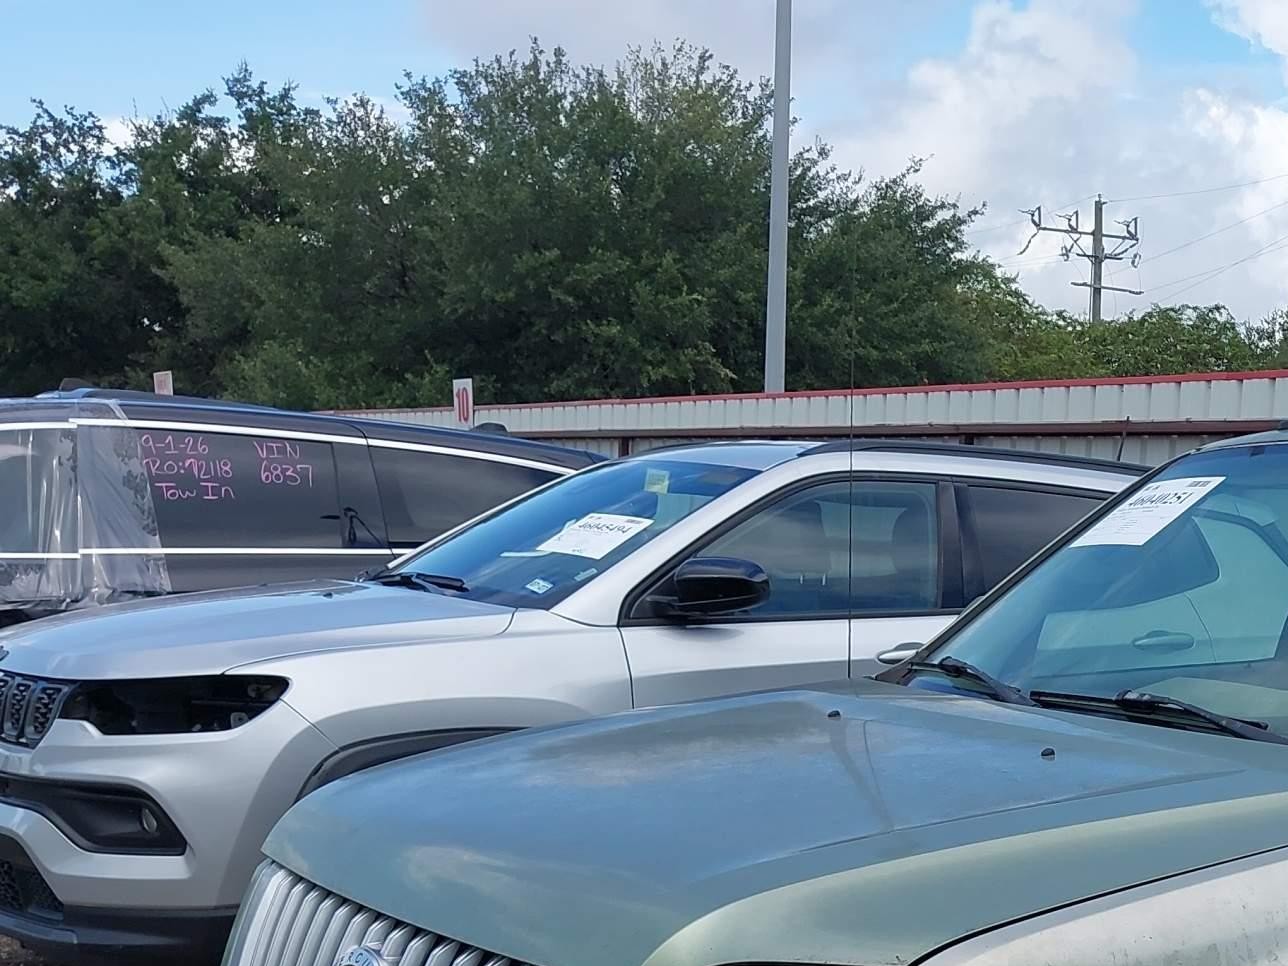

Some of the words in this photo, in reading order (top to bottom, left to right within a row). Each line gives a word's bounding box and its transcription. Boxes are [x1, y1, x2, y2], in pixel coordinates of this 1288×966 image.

[455, 386, 470, 424] 10
[141, 434, 209, 454] 9-1-26
[253, 440, 300, 459] VIN
[260, 460, 313, 488] 6837
[154, 483, 197, 500] Tow
[199, 482, 235, 499] In
